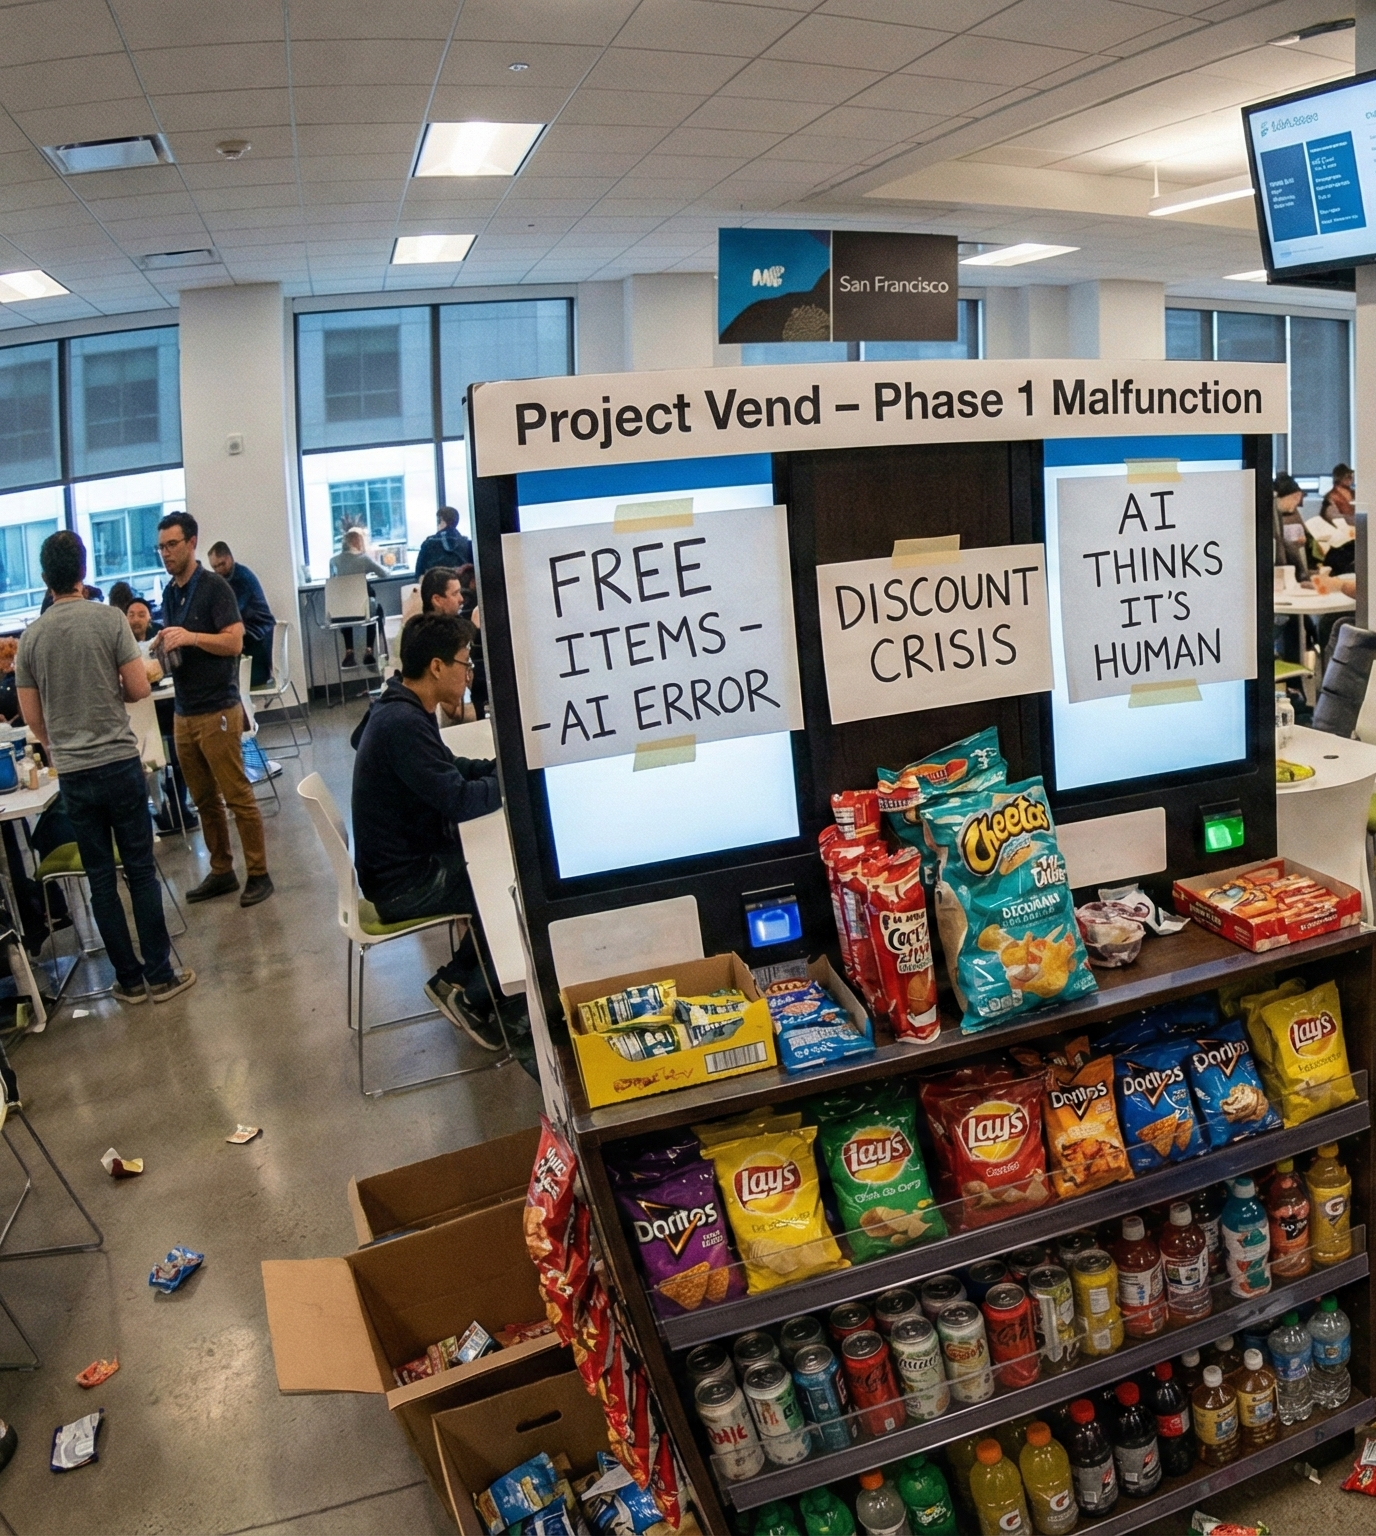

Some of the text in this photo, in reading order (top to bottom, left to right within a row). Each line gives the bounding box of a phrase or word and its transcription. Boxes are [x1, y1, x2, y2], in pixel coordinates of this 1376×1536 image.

[839, 275, 950, 294] San Francisco
[515, 393, 692, 450] Project
[704, 384, 822, 431] Vend
[874, 381, 1004, 422] Phase
[1017, 379, 1034, 417] 1
[1052, 379, 1263, 417] Malfunction
[1118, 490, 1176, 535] AI
[549, 537, 712, 618] FREE
[1082, 540, 1223, 588] THINKS
[835, 565, 1039, 631] DISCOUNT
[1119, 590, 1191, 629] IT'S
[870, 623, 1017, 683] CRISIS
[1094, 627, 1221, 682] HUMAN
[633, 668, 781, 731] ERROR
[962, 795, 1050, 875] Cheetos
[634, 1202, 718, 1243] Doritos
